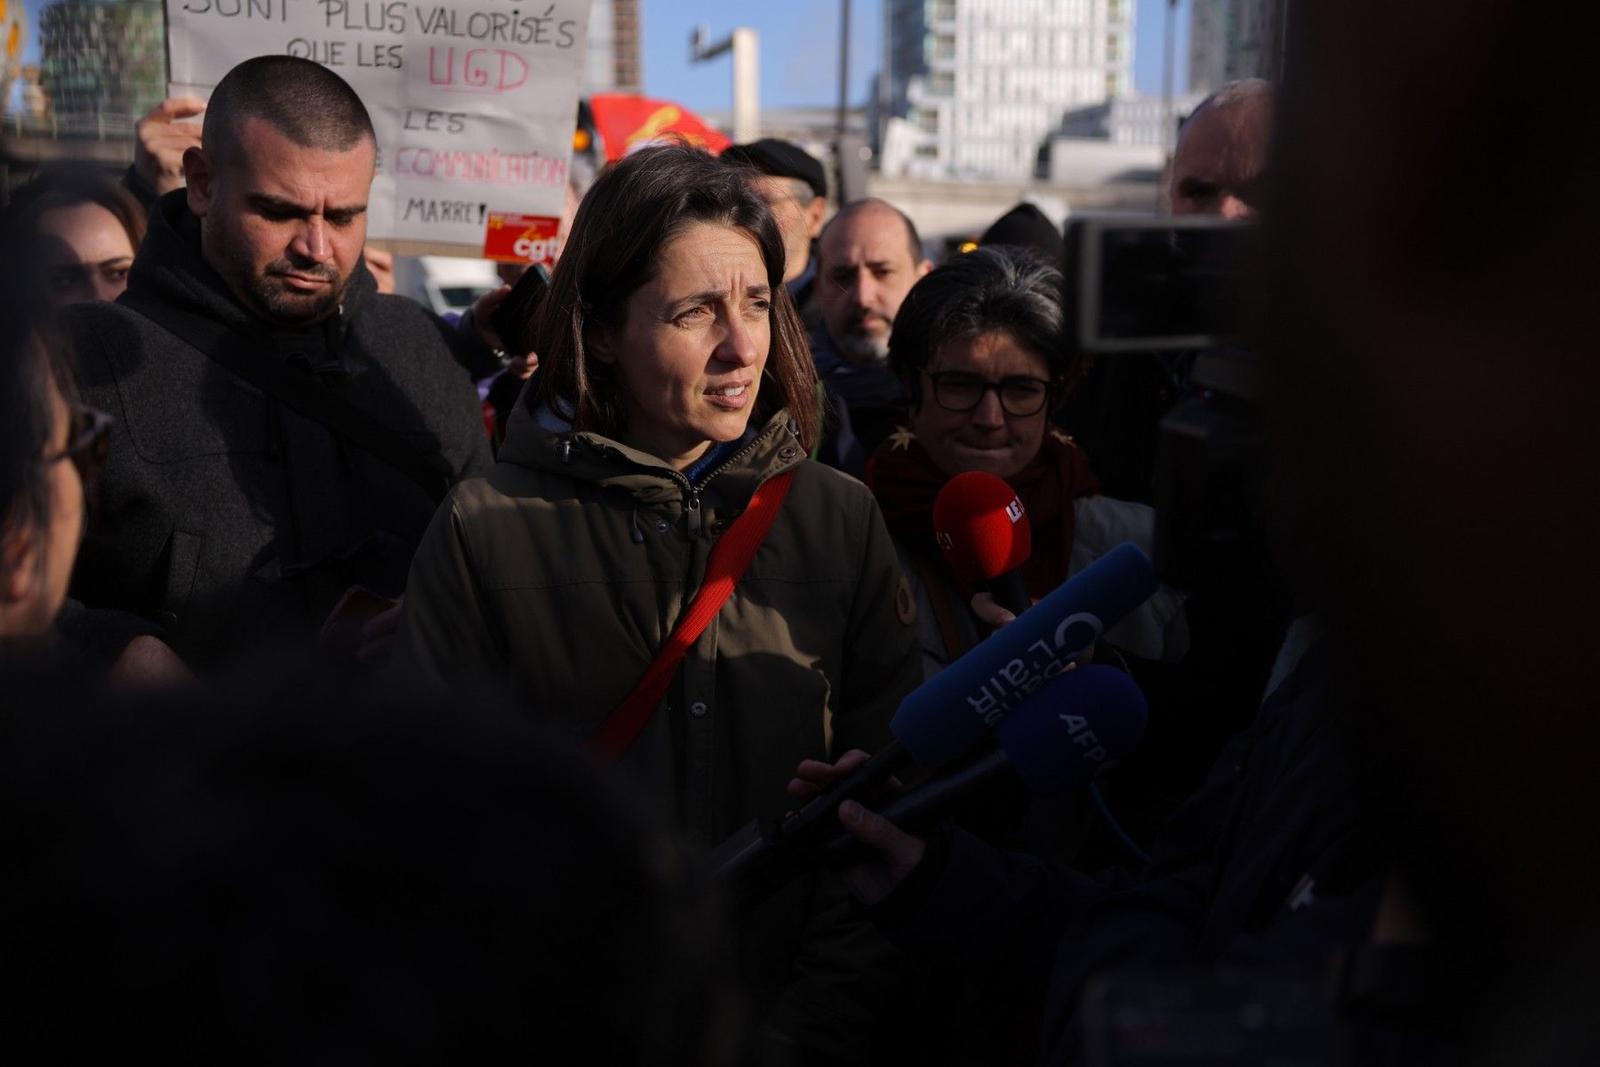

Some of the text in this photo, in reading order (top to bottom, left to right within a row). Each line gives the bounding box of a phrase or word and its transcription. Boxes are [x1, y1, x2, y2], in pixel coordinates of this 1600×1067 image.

[318, 0, 408, 34] PLUS
[286, 38, 529, 91] QUE LES UGD
[403, 111, 466, 133] LES
[1059, 713, 1108, 762] AFP
